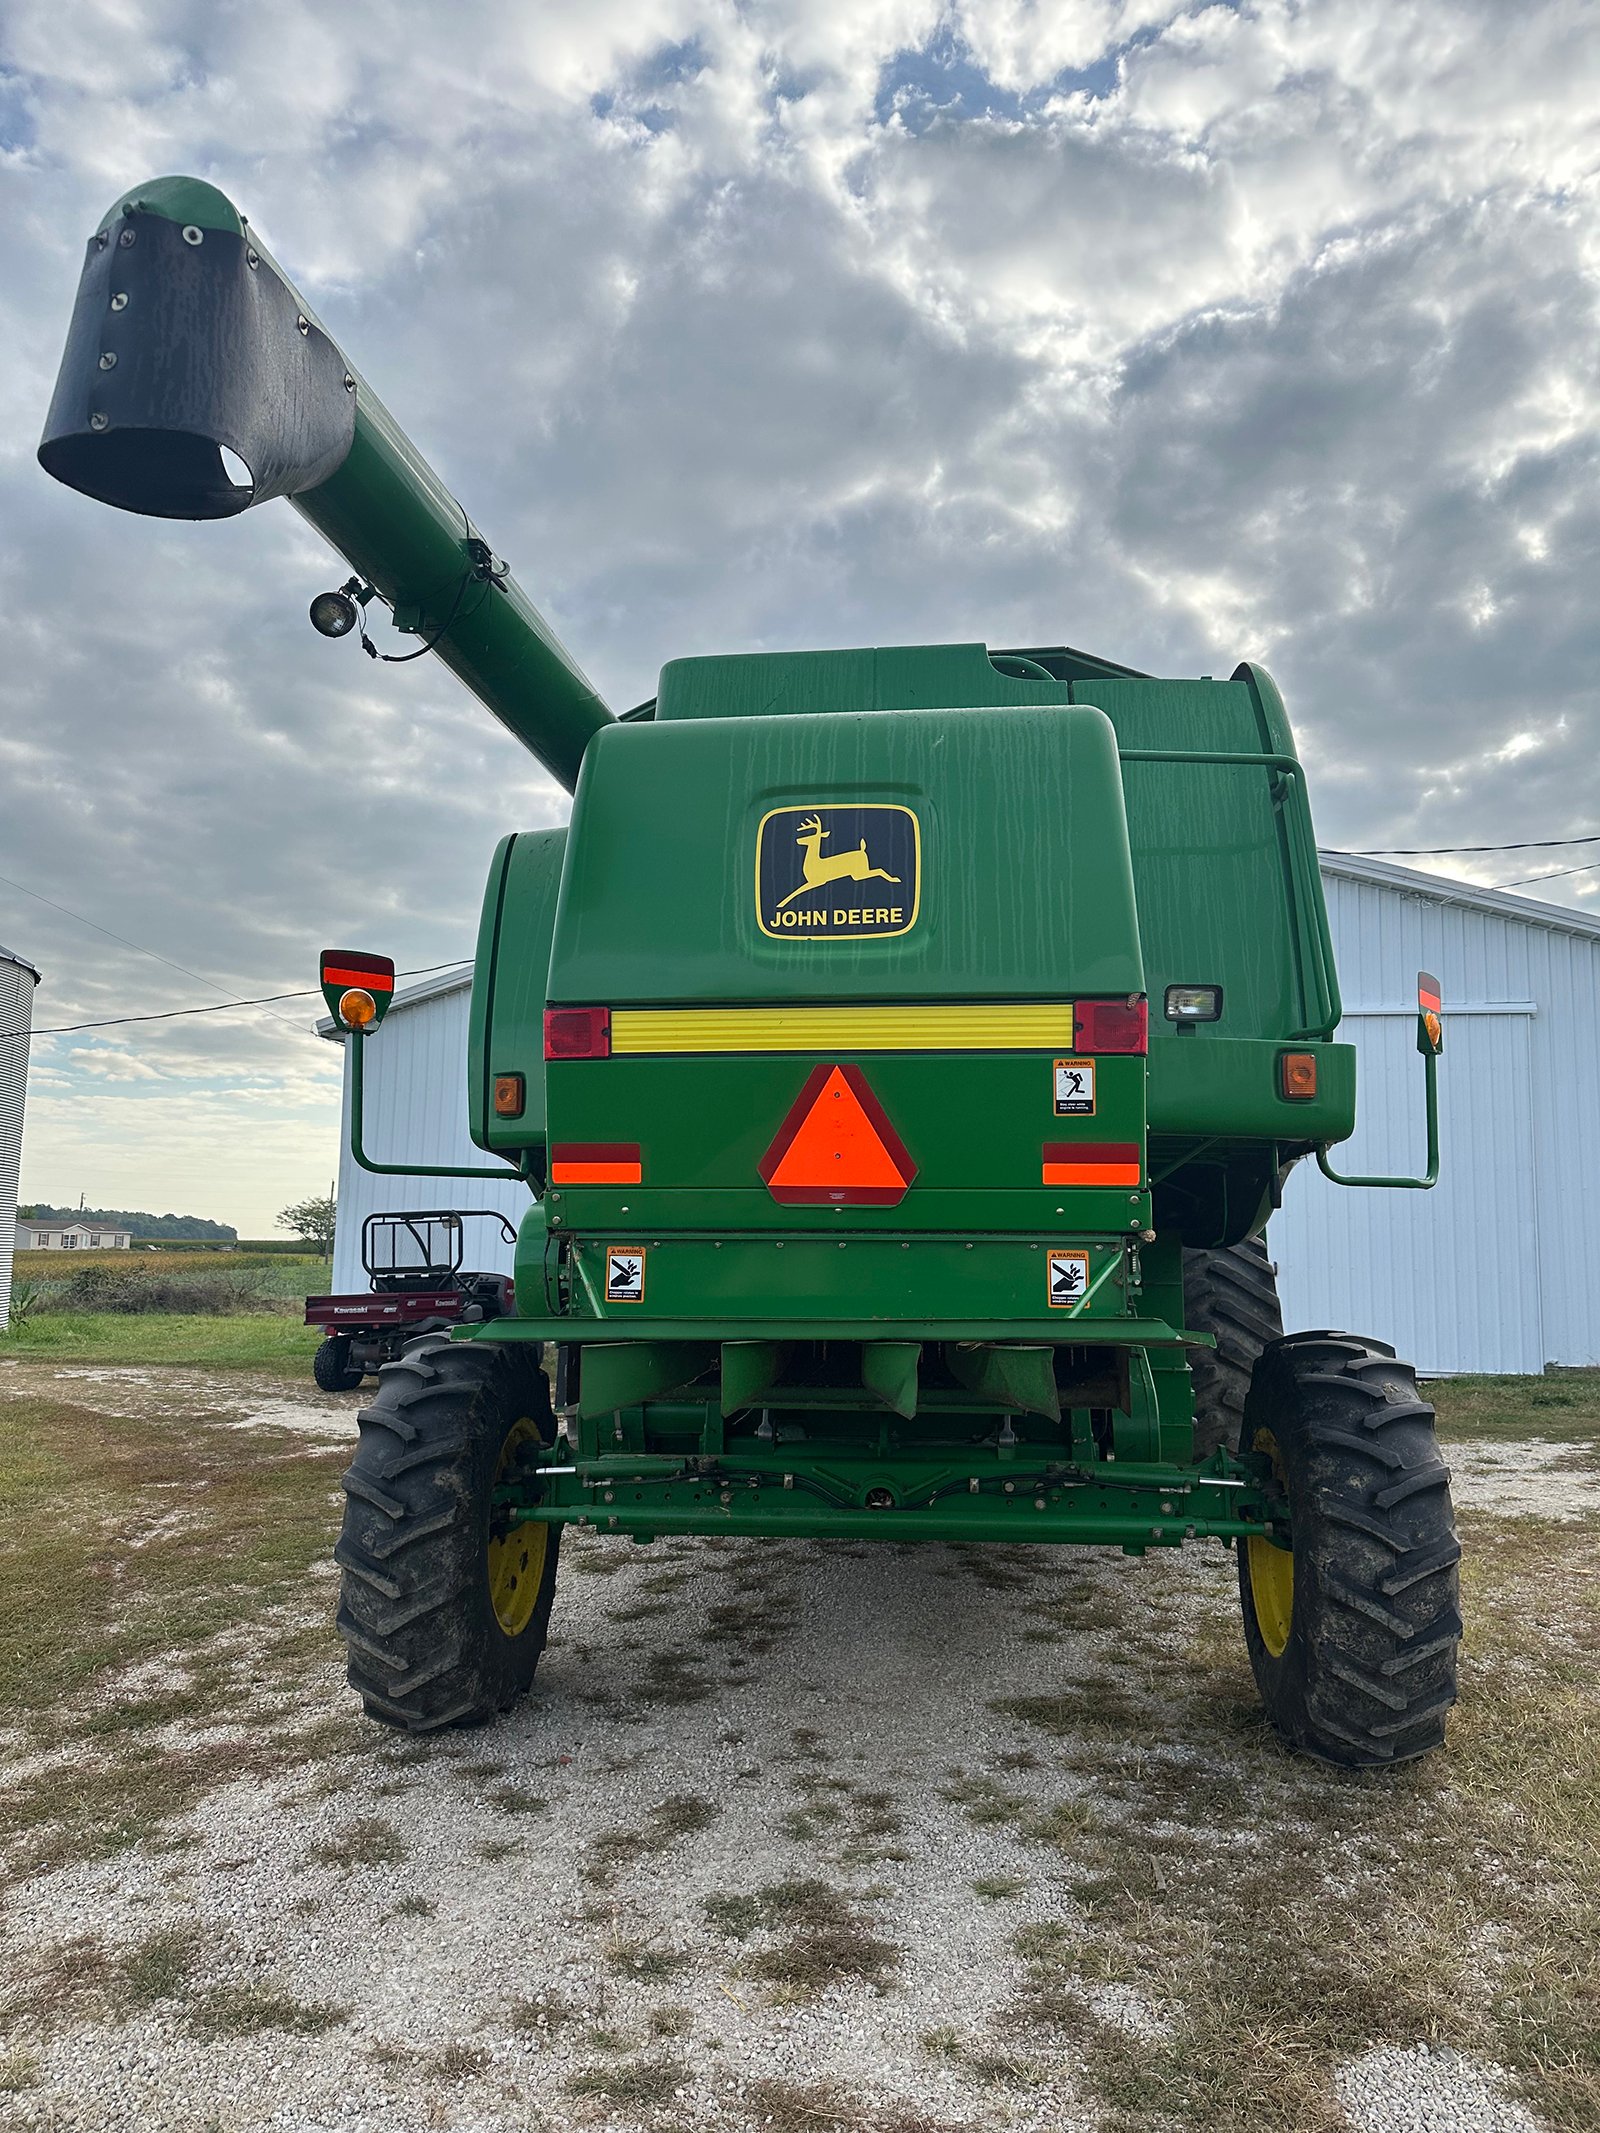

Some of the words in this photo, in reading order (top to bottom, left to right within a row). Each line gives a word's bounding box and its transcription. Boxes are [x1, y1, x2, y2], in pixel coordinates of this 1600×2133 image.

[770, 910, 827, 928] JOHN
[833, 907, 903, 925] DEERE
[334, 1306, 368, 1314] Kawasaki
